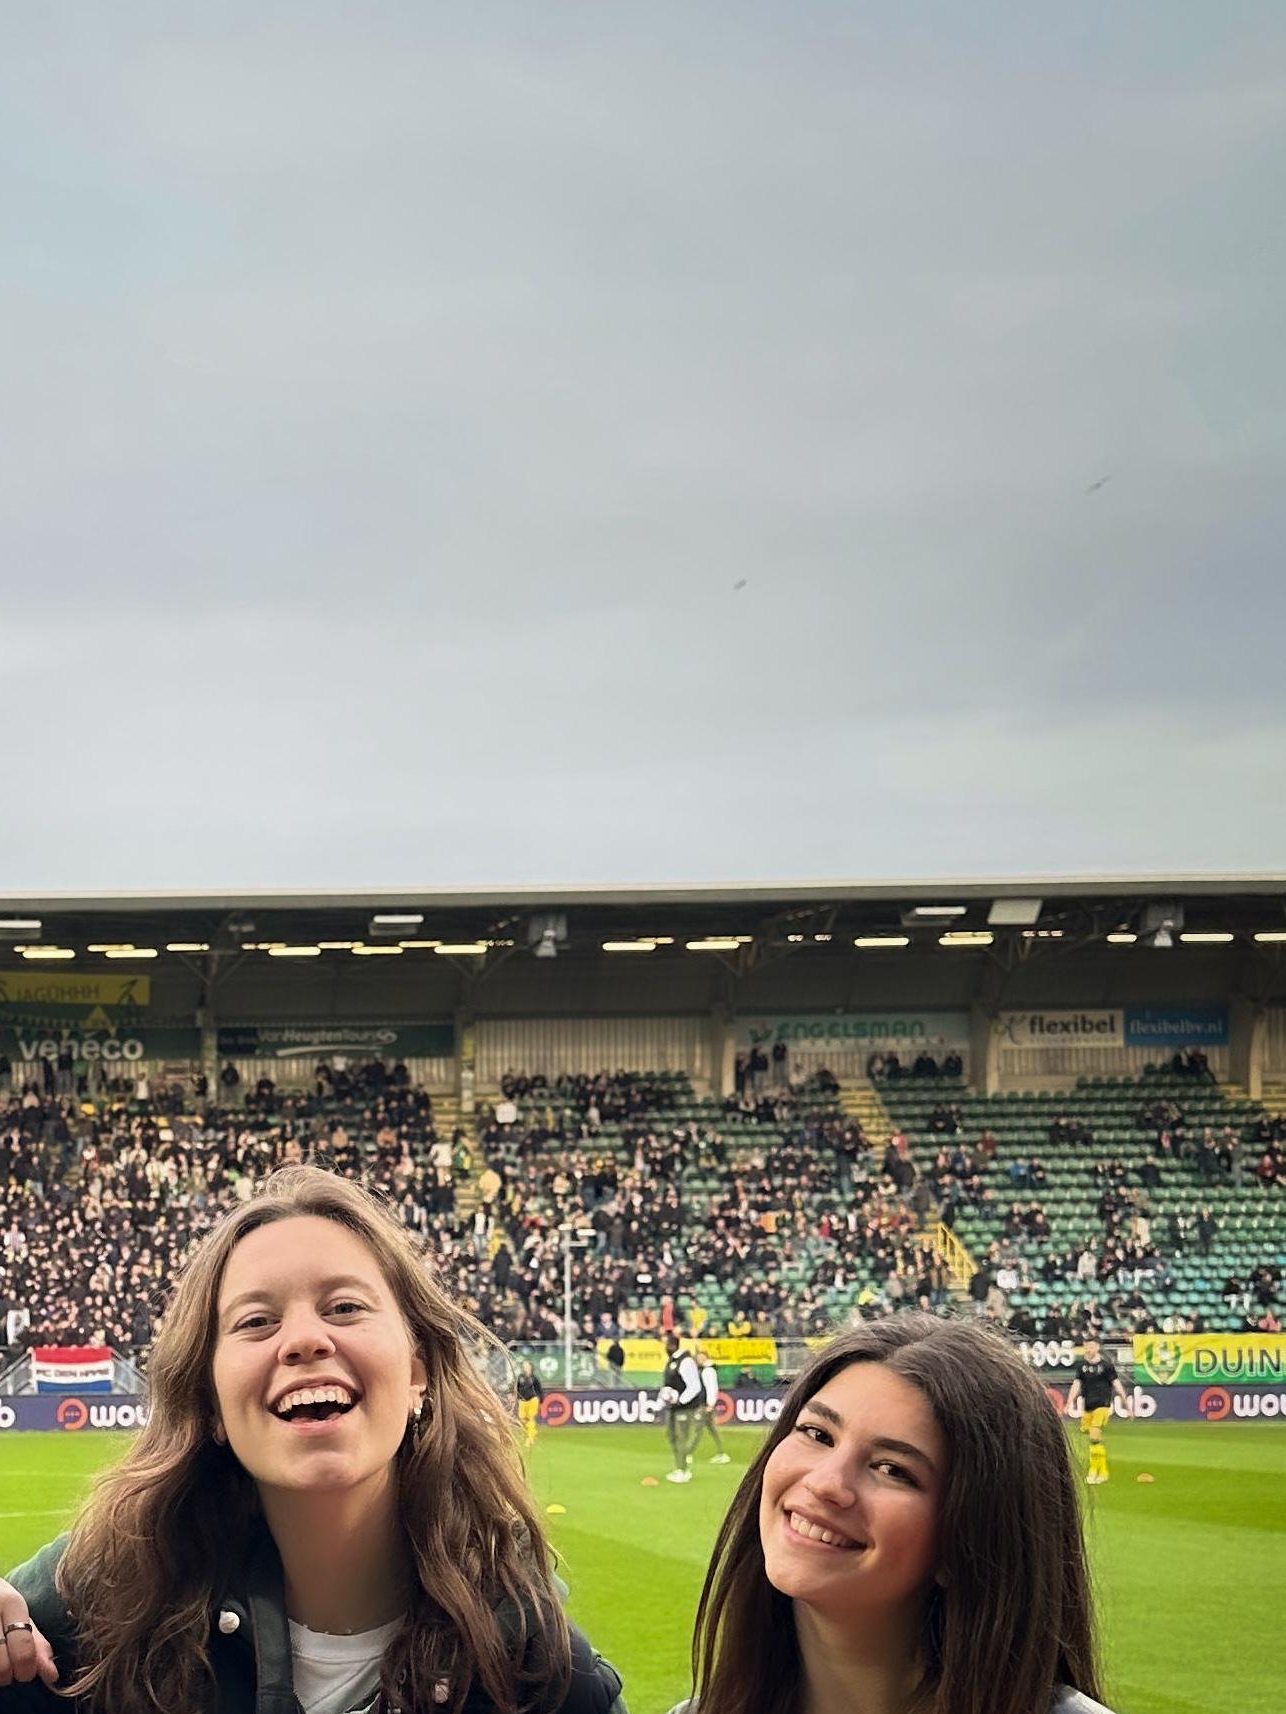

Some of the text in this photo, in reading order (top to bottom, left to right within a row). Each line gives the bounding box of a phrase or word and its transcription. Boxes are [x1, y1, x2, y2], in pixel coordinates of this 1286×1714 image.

[1028, 1014, 1116, 1035] flexibel
[1194, 1348, 1282, 1377] DUIN
[90, 1404, 150, 1428] wou
